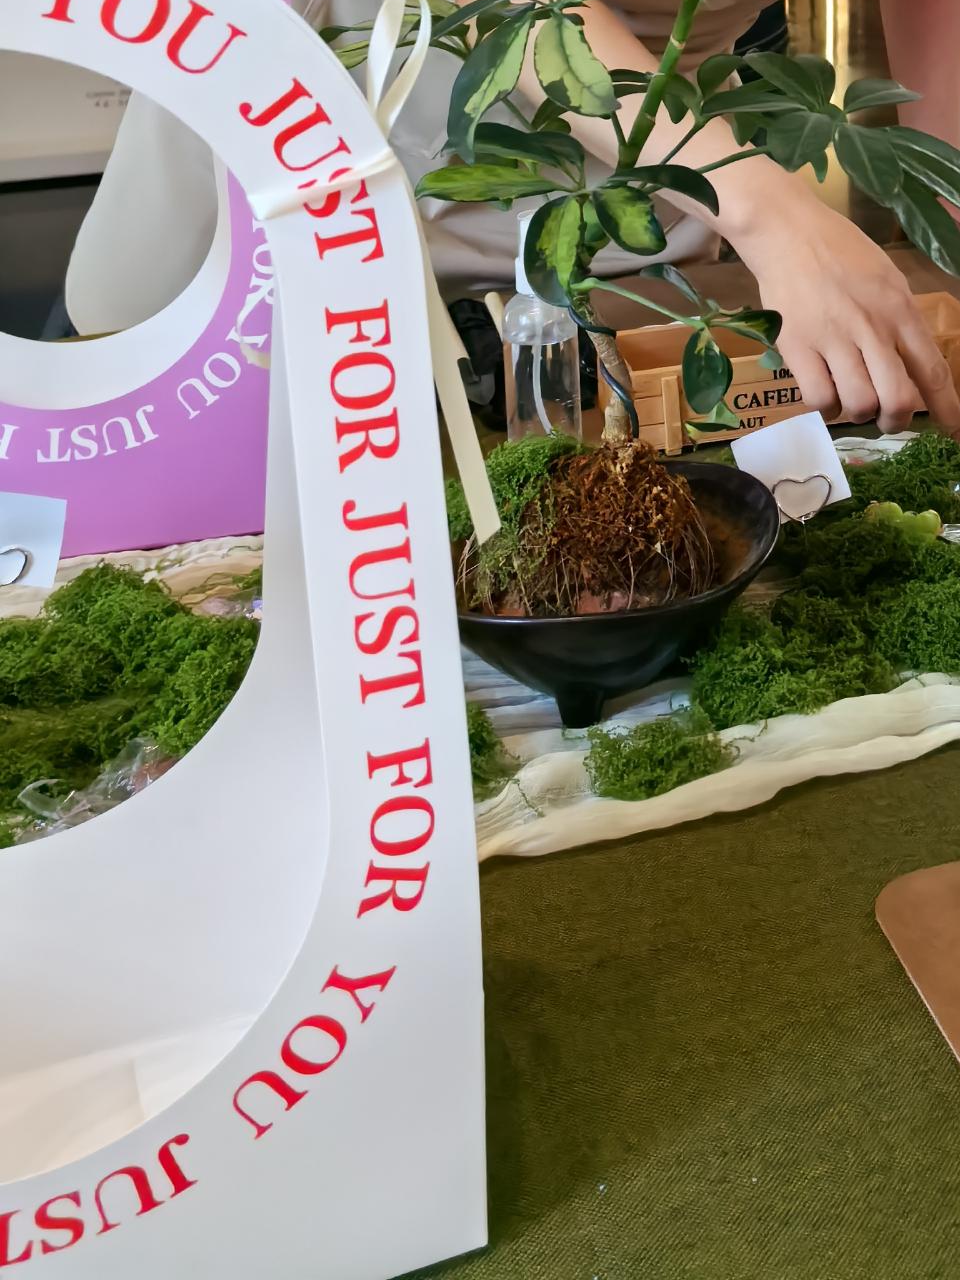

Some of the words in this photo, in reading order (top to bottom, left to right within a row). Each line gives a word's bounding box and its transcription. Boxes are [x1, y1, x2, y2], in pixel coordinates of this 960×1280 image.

[238, 77, 386, 263] JUST
[36, 404, 159, 463] JUST
[324, 298, 402, 475] FOR
[733, 386, 803, 410] CAFED
[739, 416, 766, 429] AUT
[341, 499, 426, 709] JUST
[356, 738, 435, 919] FOR
[232, 964, 397, 1140] YOU
[0, 1133, 198, 1268] JUST
